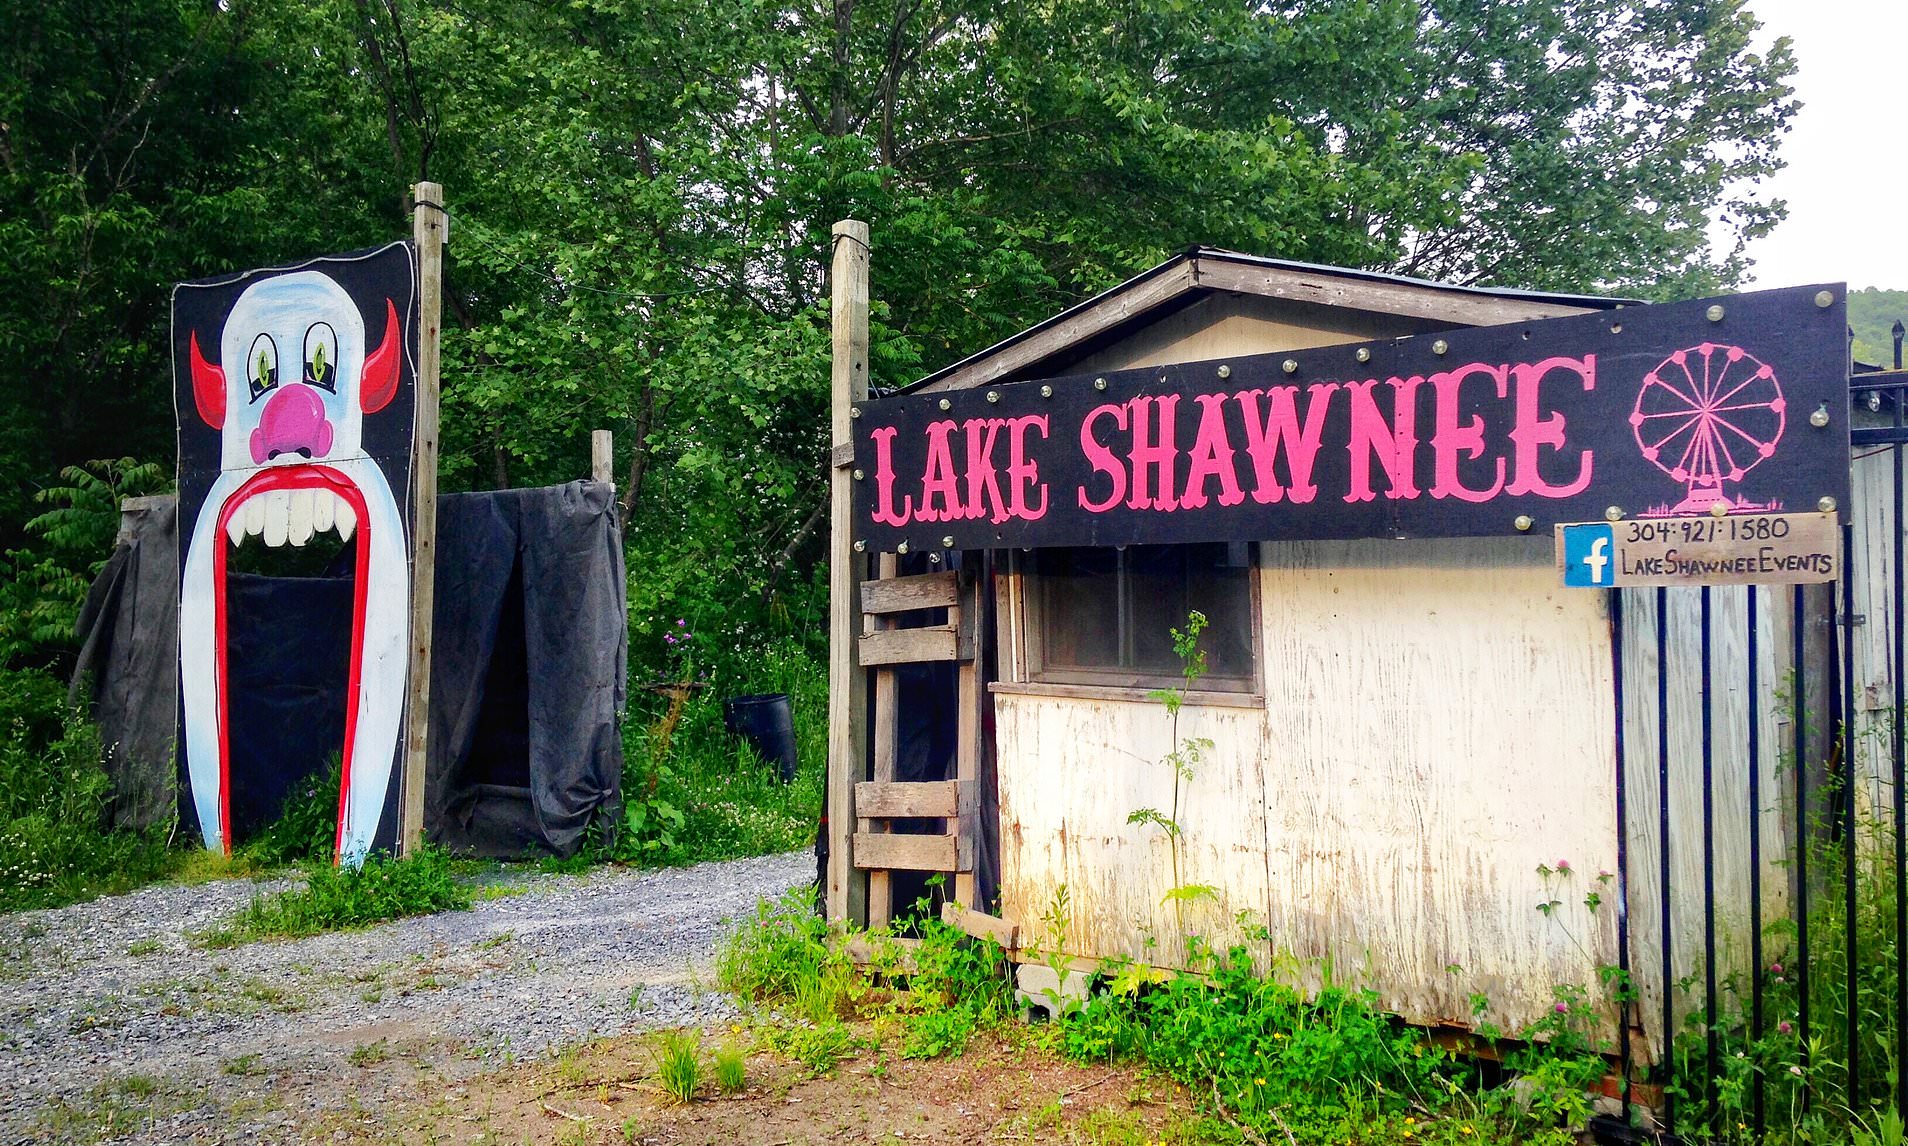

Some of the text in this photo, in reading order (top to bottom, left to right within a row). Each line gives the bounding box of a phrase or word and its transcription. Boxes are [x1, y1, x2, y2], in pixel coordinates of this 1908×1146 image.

[871, 354, 1596, 527] LAKE SHAWNEE
[1583, 537, 1608, 583] f
